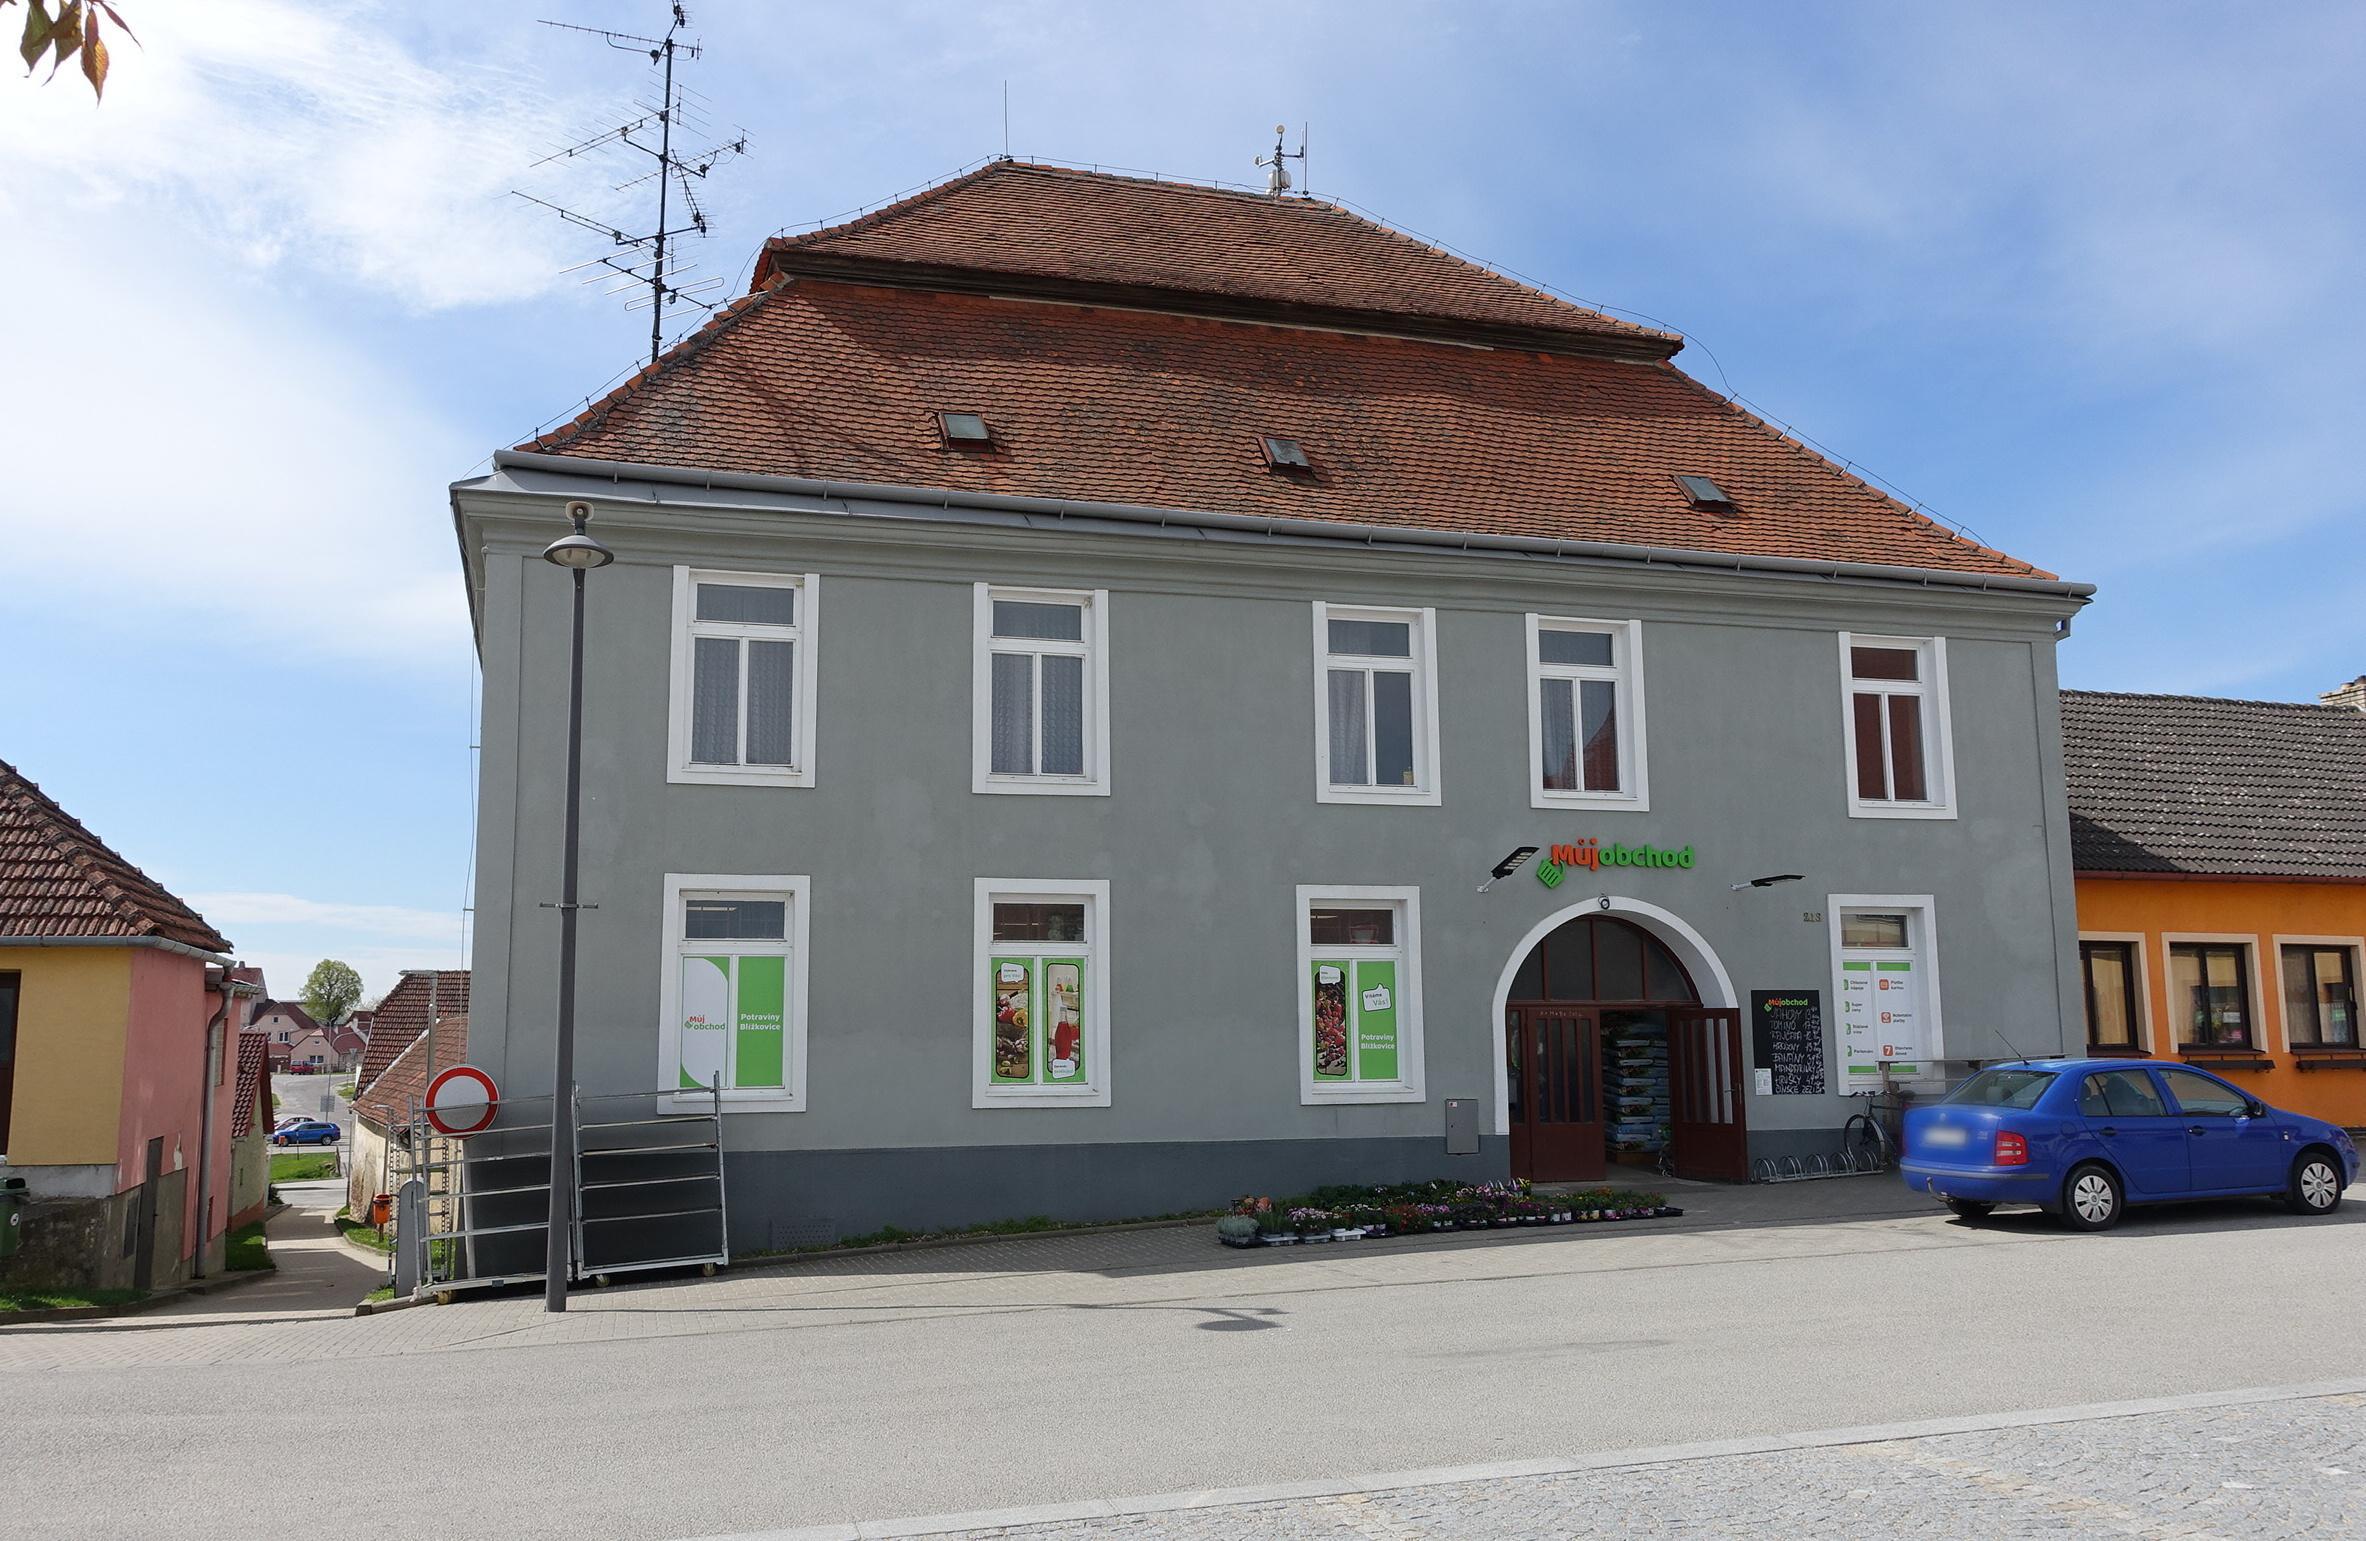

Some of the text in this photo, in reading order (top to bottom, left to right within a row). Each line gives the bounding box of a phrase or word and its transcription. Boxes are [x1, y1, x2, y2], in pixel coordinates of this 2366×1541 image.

[689, 1014, 705, 1024] Můj
[740, 1013, 780, 1022] Potraviny
[693, 1022, 726, 1030] obchod
[1361, 1033, 1395, 1041] Potraviny
